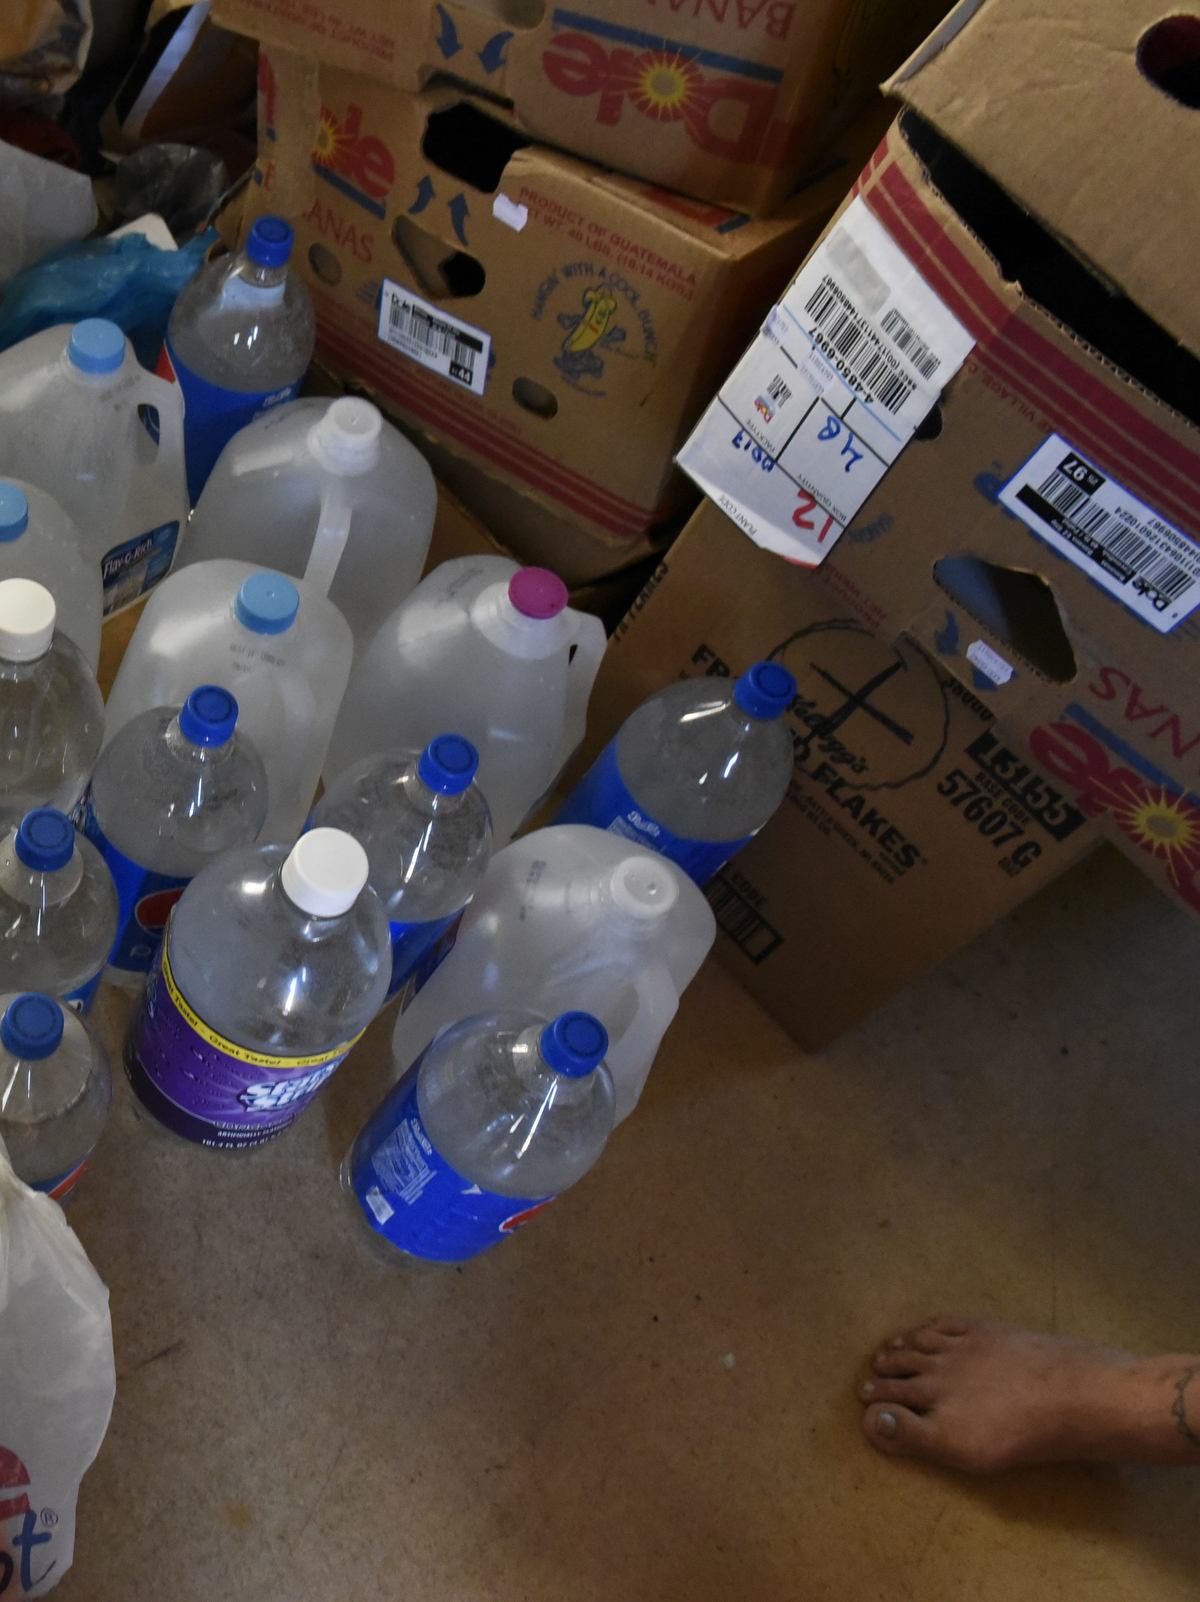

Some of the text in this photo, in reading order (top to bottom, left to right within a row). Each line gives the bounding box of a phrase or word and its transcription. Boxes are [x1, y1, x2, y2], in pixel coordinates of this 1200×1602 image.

[542, 30, 777, 167] Dole
[518, 186, 697, 284] PRODUCT OF GUATEMALA
[567, 228, 583, 242] 40
[456, 367, 472, 382] 44
[806, 325, 875, 405] 4-4850-6967
[743, 419, 777, 452] PACKTYPE
[1061, 455, 1090, 482] 97
[734, 511, 758, 535] PLANT
[795, 471, 847, 523] BOX QUANTITY
[1128, 575, 1170, 613] Dole
[974, 770, 1031, 827] BASE CODE
[977, 737, 1074, 830] 13155
[811, 760, 923, 871] FLAKES
[934, 766, 1024, 854] 57607
[1009, 835, 1044, 870] G
[209, 1034, 239, 1057] Great
